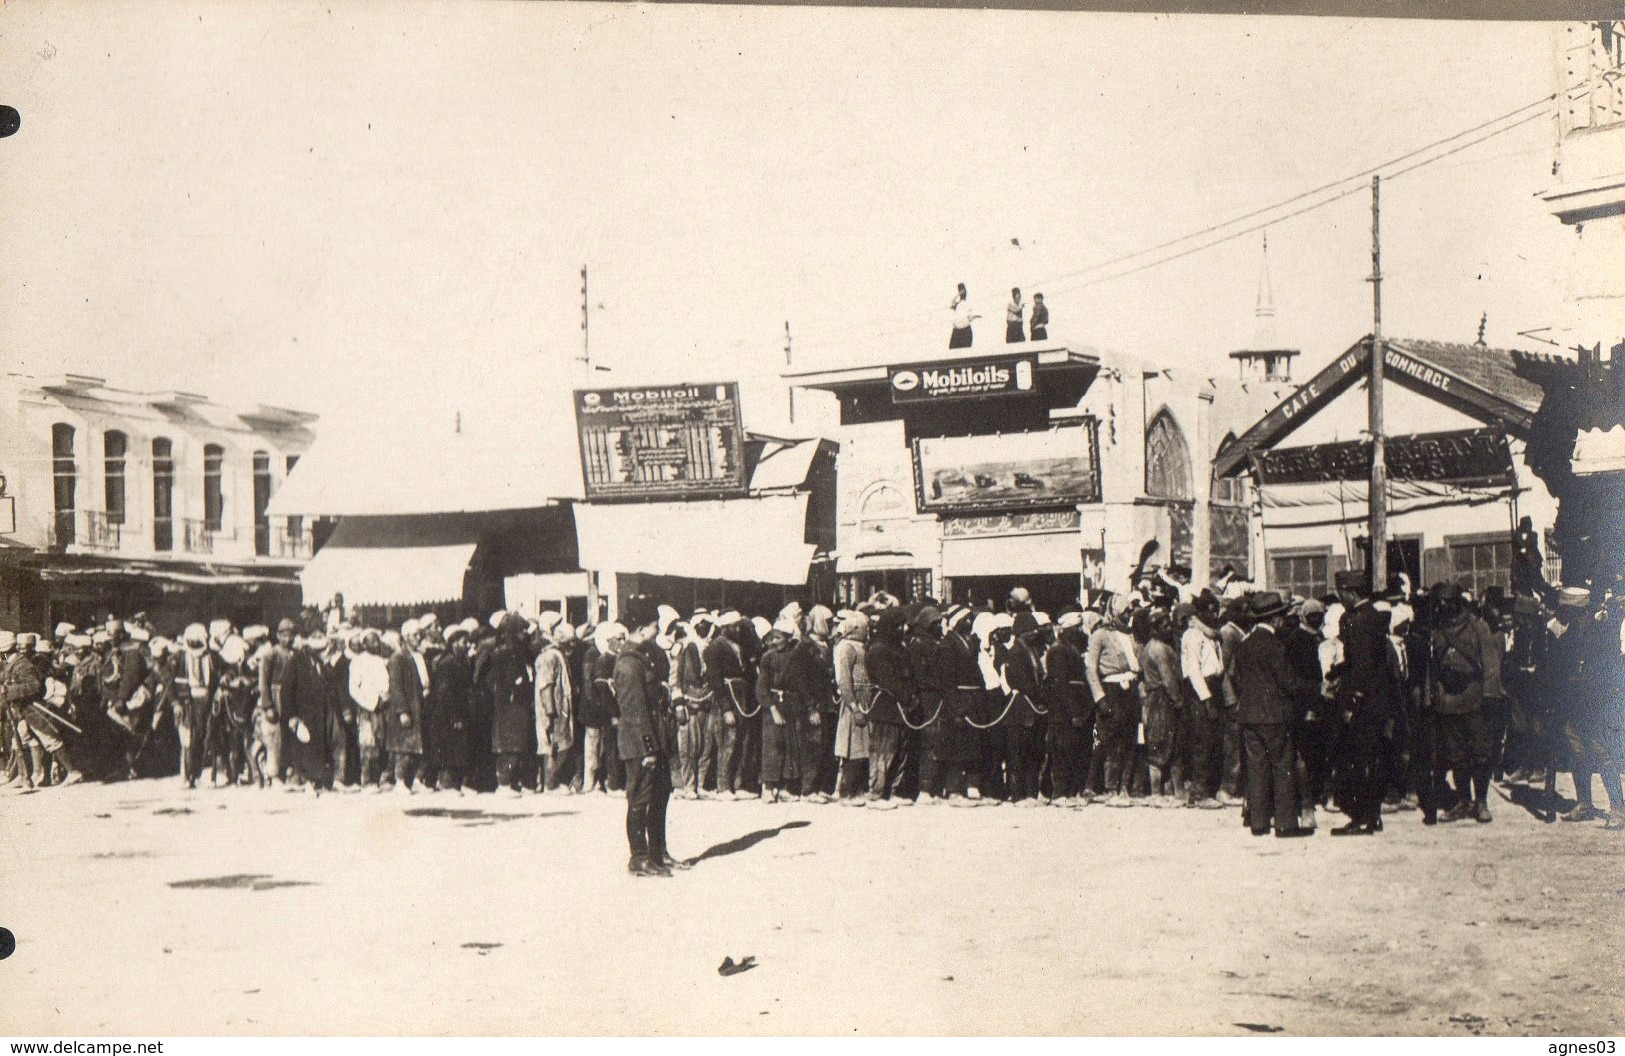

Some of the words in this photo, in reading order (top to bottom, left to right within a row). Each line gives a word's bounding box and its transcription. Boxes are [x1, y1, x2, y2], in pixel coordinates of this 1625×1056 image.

[922, 365, 1010, 389] Mobiloils
[1282, 383, 1320, 419] CAFE
[1340, 353, 1358, 374] DU
[1385, 350, 1450, 391] COMMERCE
[613, 387, 699, 401] Mobiloil
